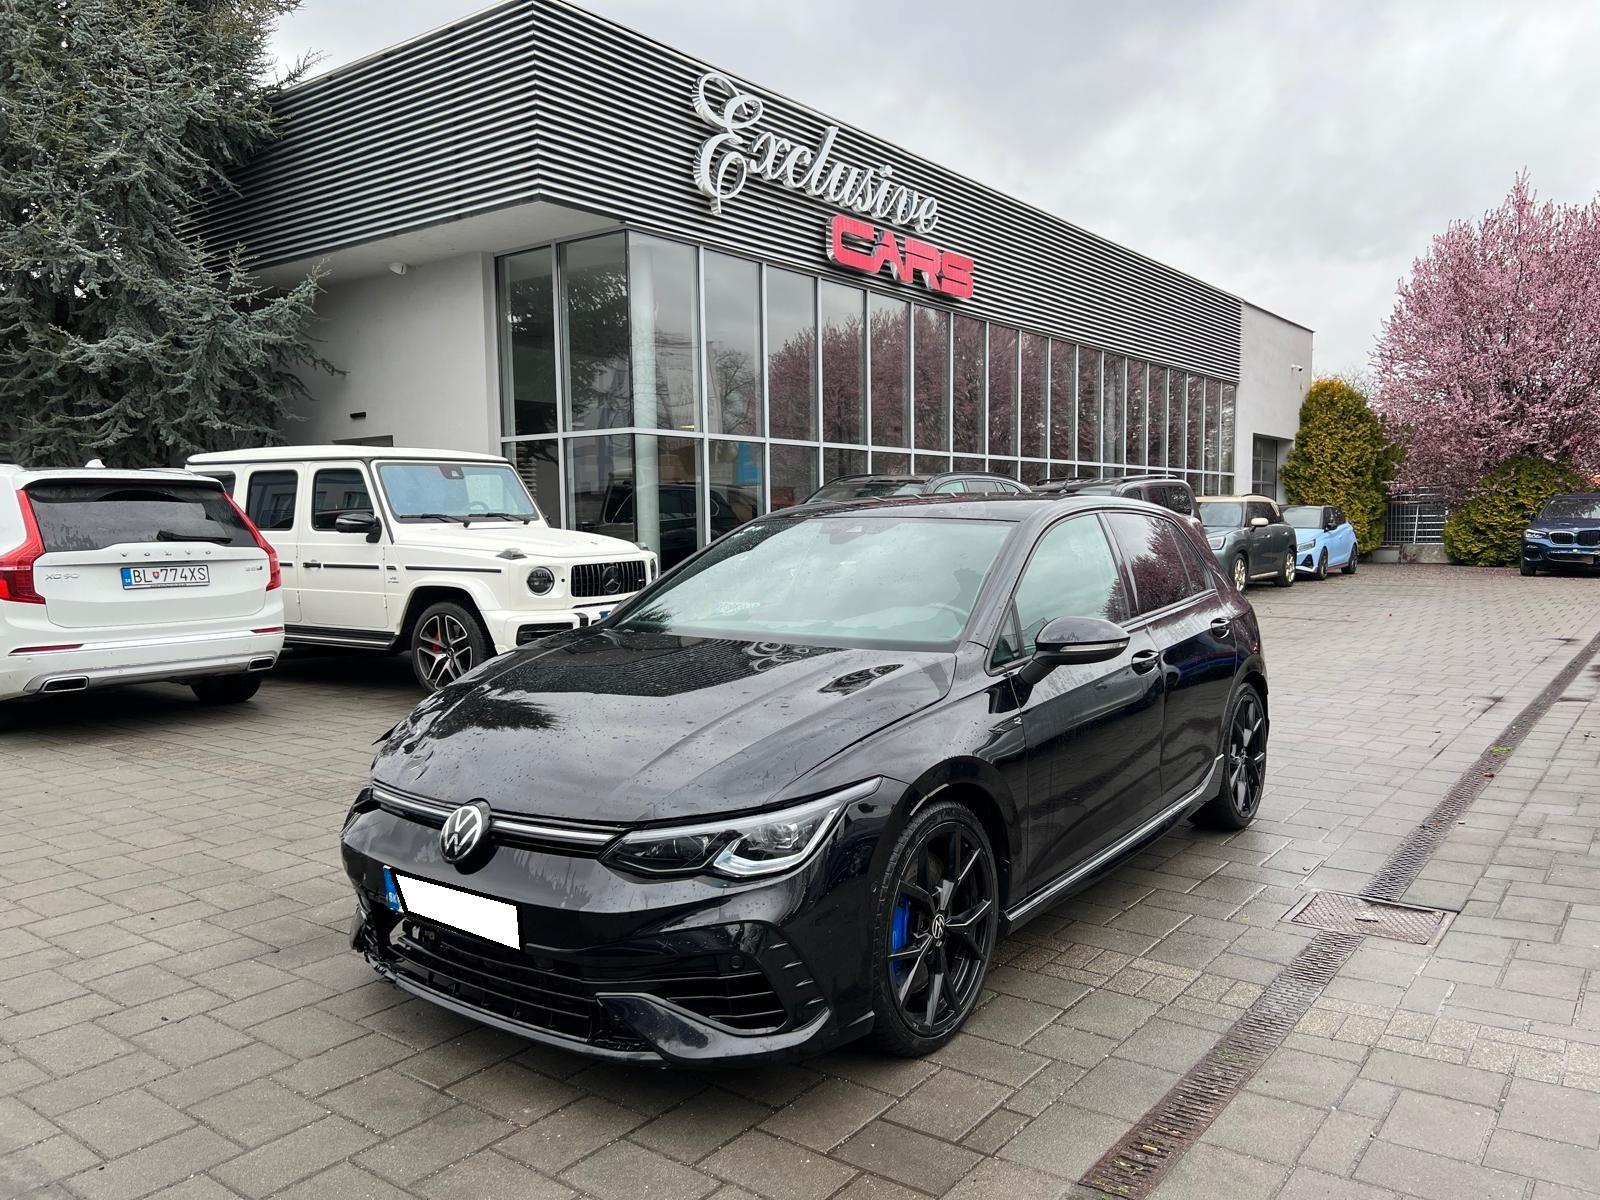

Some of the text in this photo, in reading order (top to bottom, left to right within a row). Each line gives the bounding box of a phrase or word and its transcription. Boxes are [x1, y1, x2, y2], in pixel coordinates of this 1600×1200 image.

[692, 72, 940, 234] Exclusive
[826, 213, 975, 299] CARS
[133, 567, 206, 584] BL 774XS
